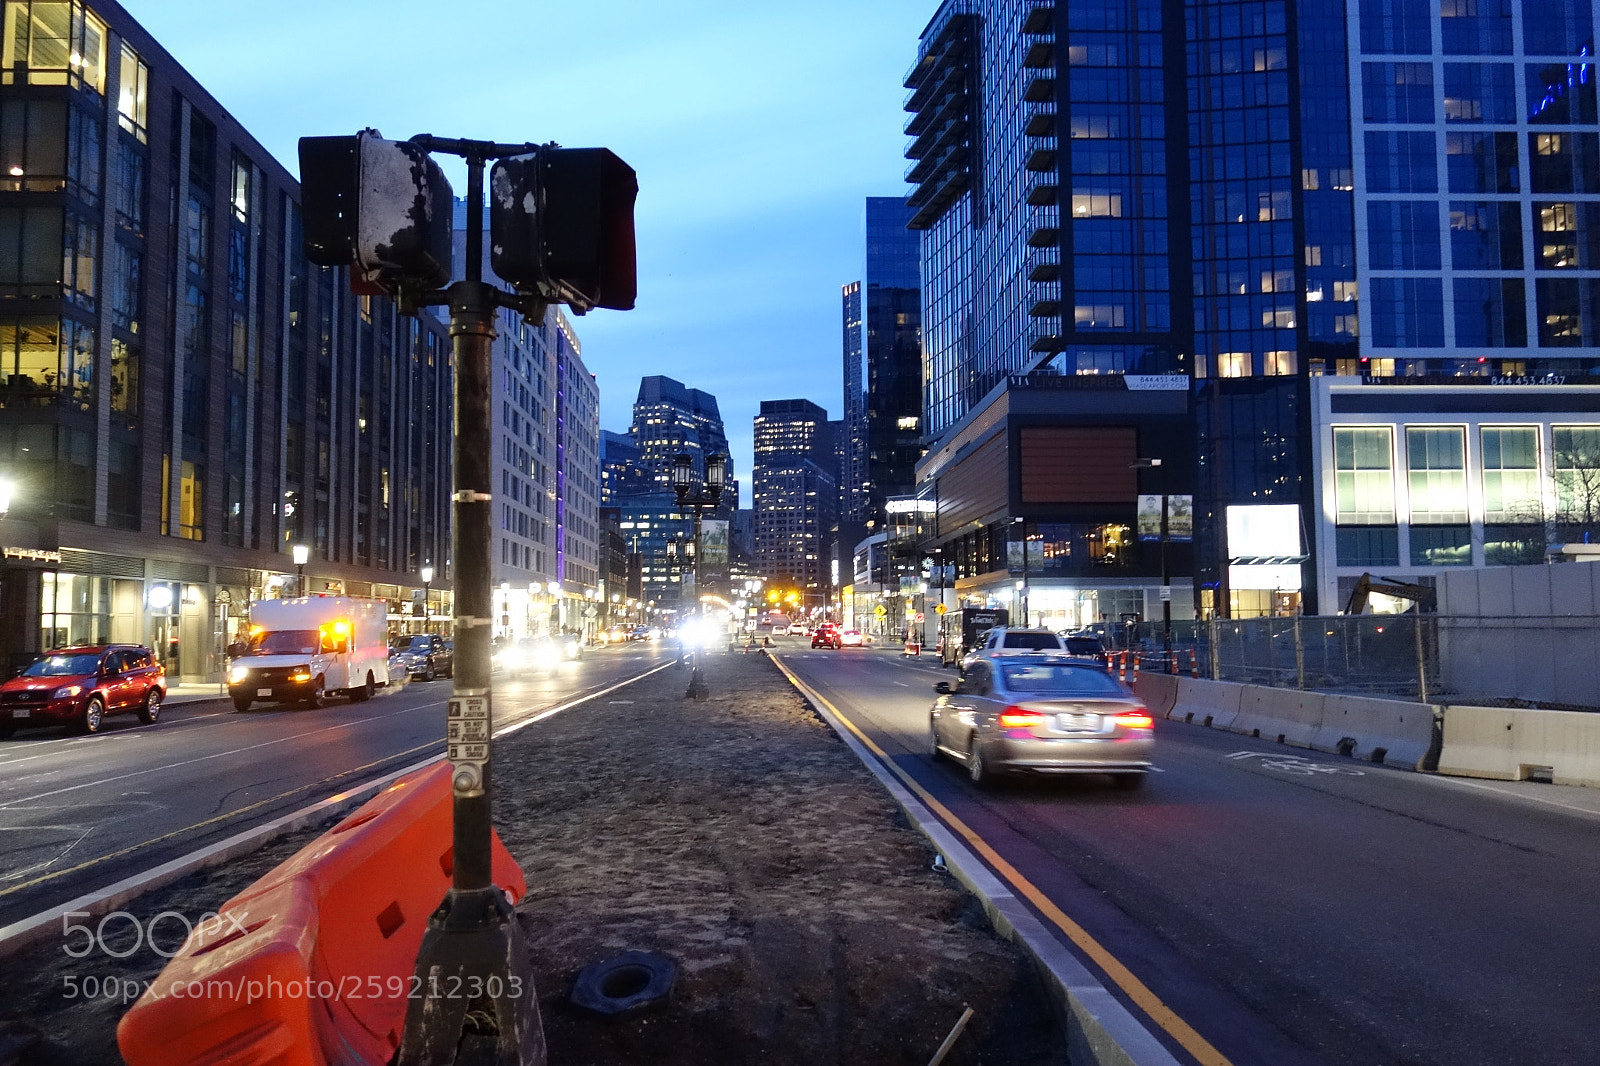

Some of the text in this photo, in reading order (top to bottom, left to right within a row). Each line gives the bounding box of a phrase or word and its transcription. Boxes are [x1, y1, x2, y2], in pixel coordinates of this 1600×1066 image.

[1034, 377, 1065, 388] LIVE
[1068, 377, 1124, 388] INSPIRED
[1491, 375, 1566, 385] 844.453.4837
